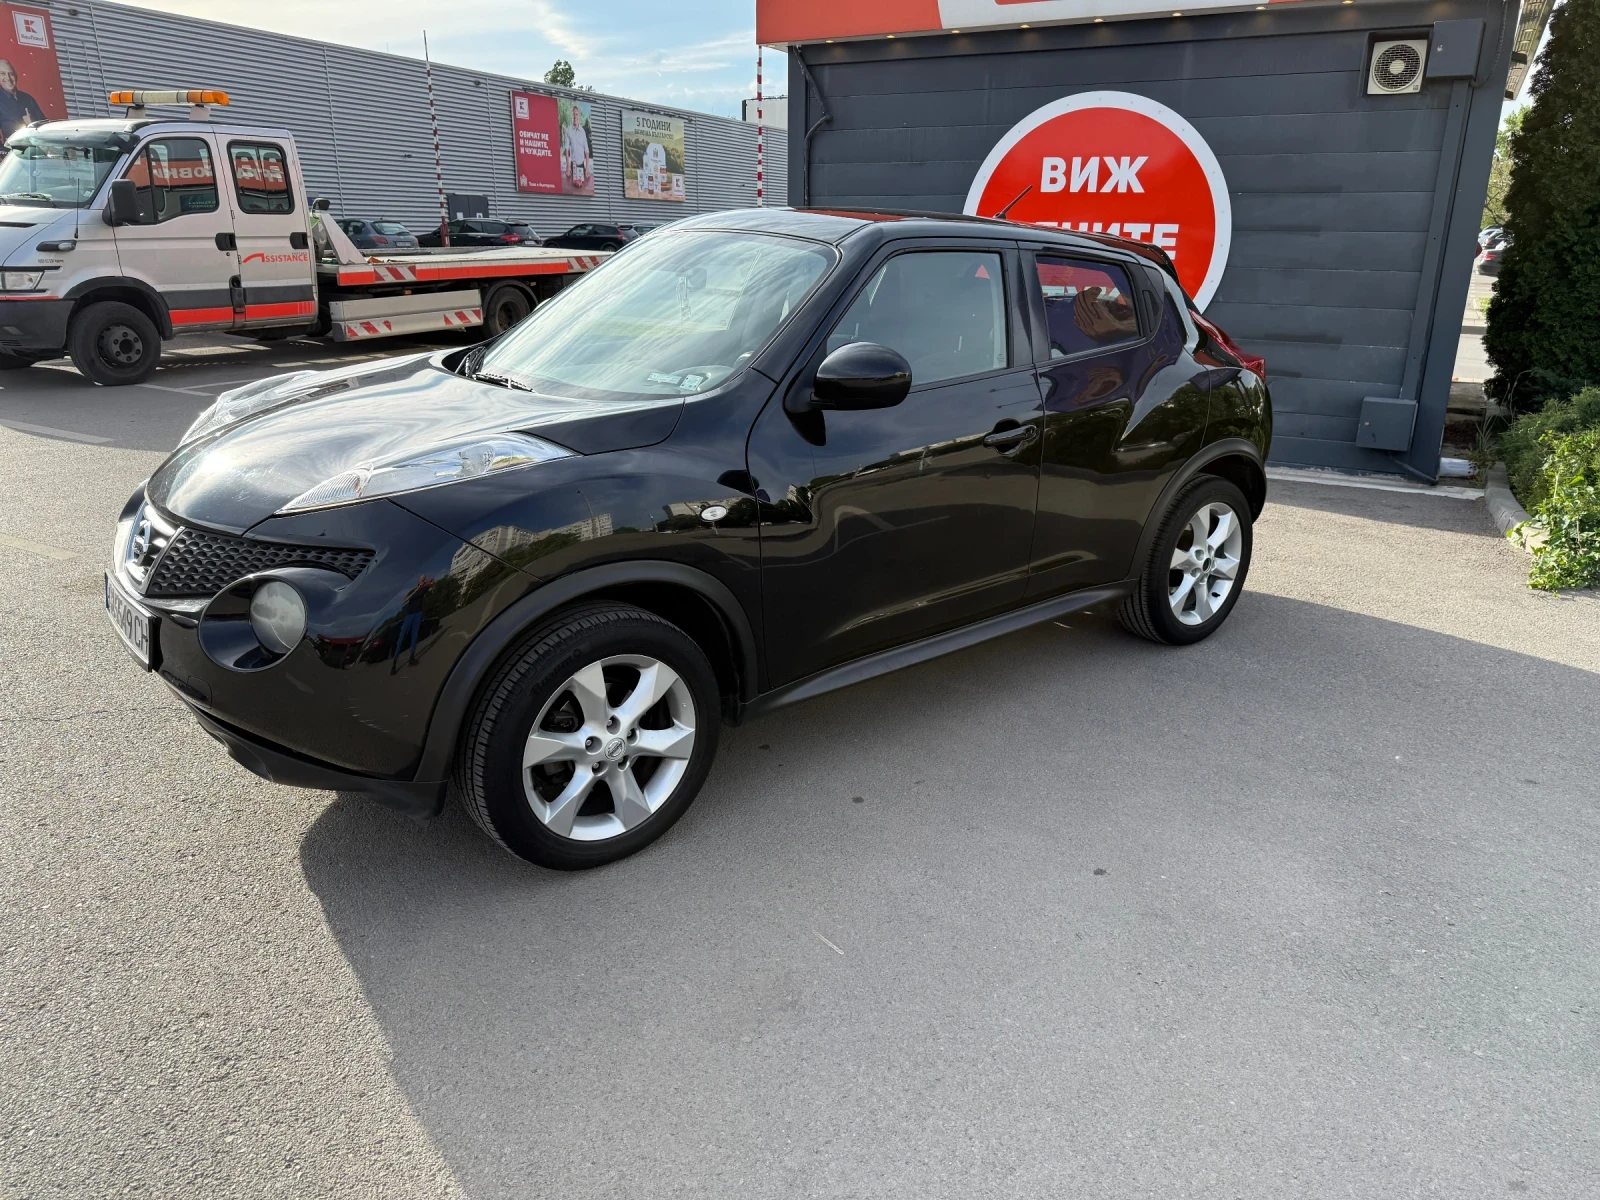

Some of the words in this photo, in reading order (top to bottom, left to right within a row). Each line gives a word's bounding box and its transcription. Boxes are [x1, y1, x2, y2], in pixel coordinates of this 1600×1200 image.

[636, 116, 641, 127] 5
[641, 117, 671, 132] ГОДИНИ
[519, 130, 540, 139] ОБИЧАТ
[519, 138, 524, 146] И
[524, 139, 548, 149] НАШИТЕ,
[525, 147, 552, 157] ЧУЖДИТЕ.
[1040, 156, 1149, 193] ВИЖ
